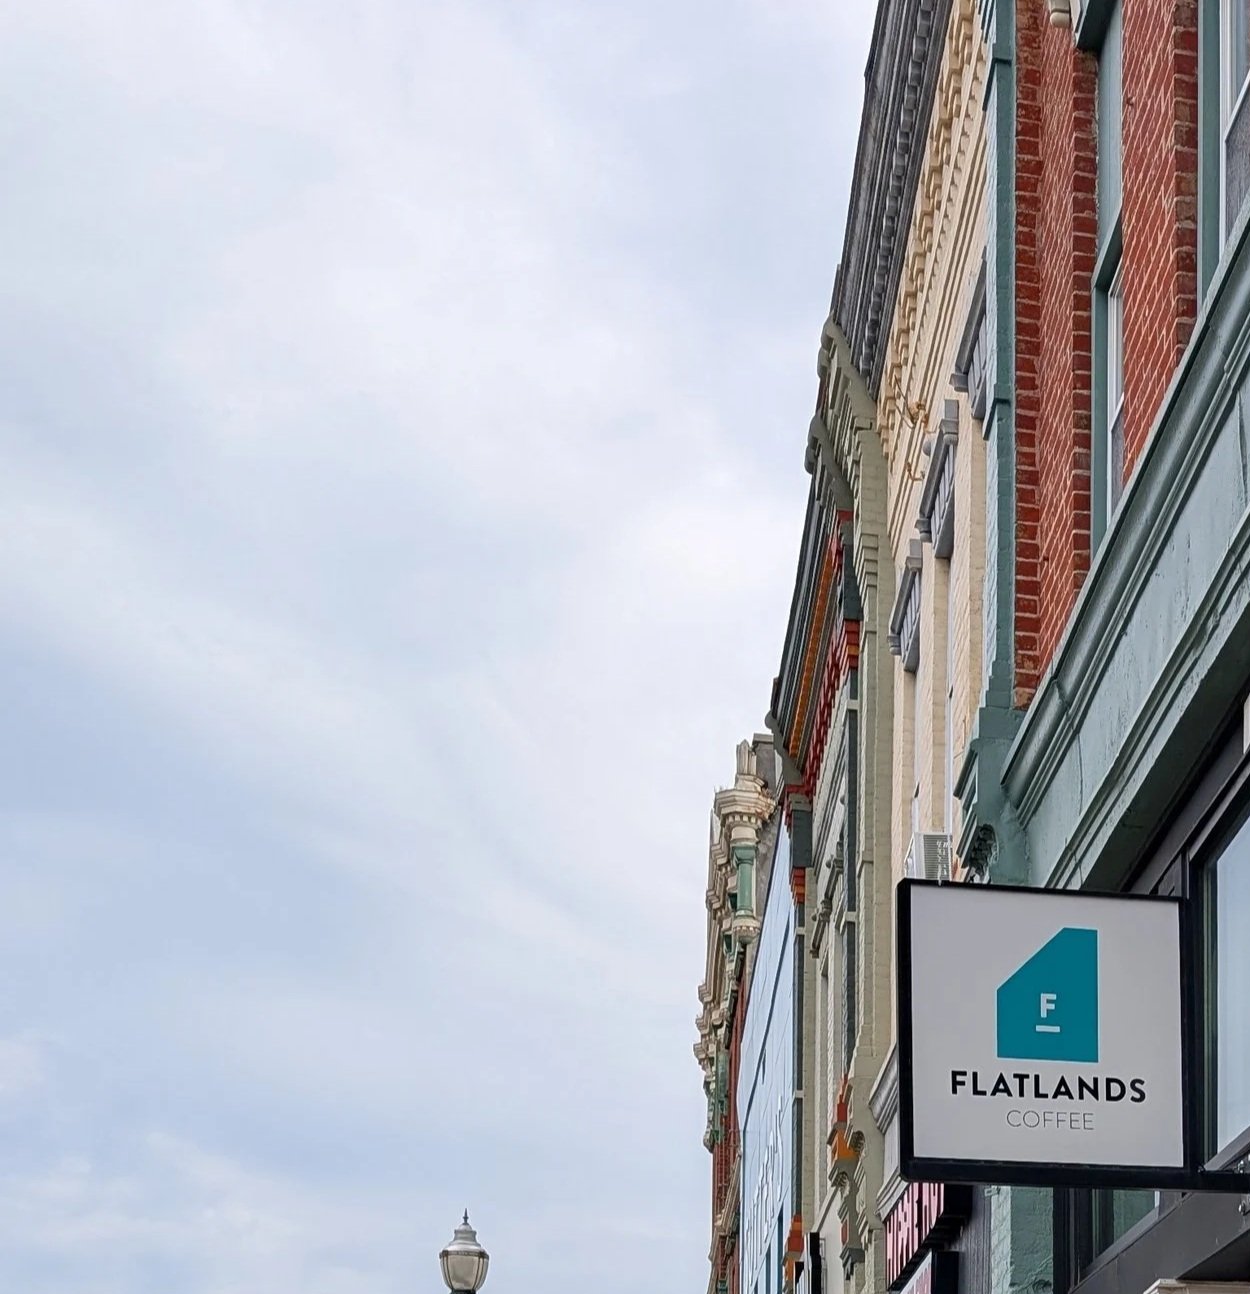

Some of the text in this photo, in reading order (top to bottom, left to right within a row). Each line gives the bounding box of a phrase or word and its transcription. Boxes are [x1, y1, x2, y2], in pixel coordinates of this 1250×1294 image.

[1040, 993, 1057, 1018] F
[951, 1070, 1146, 1103] FLATLANDS
[1006, 1110, 1094, 1130] COFFEE
